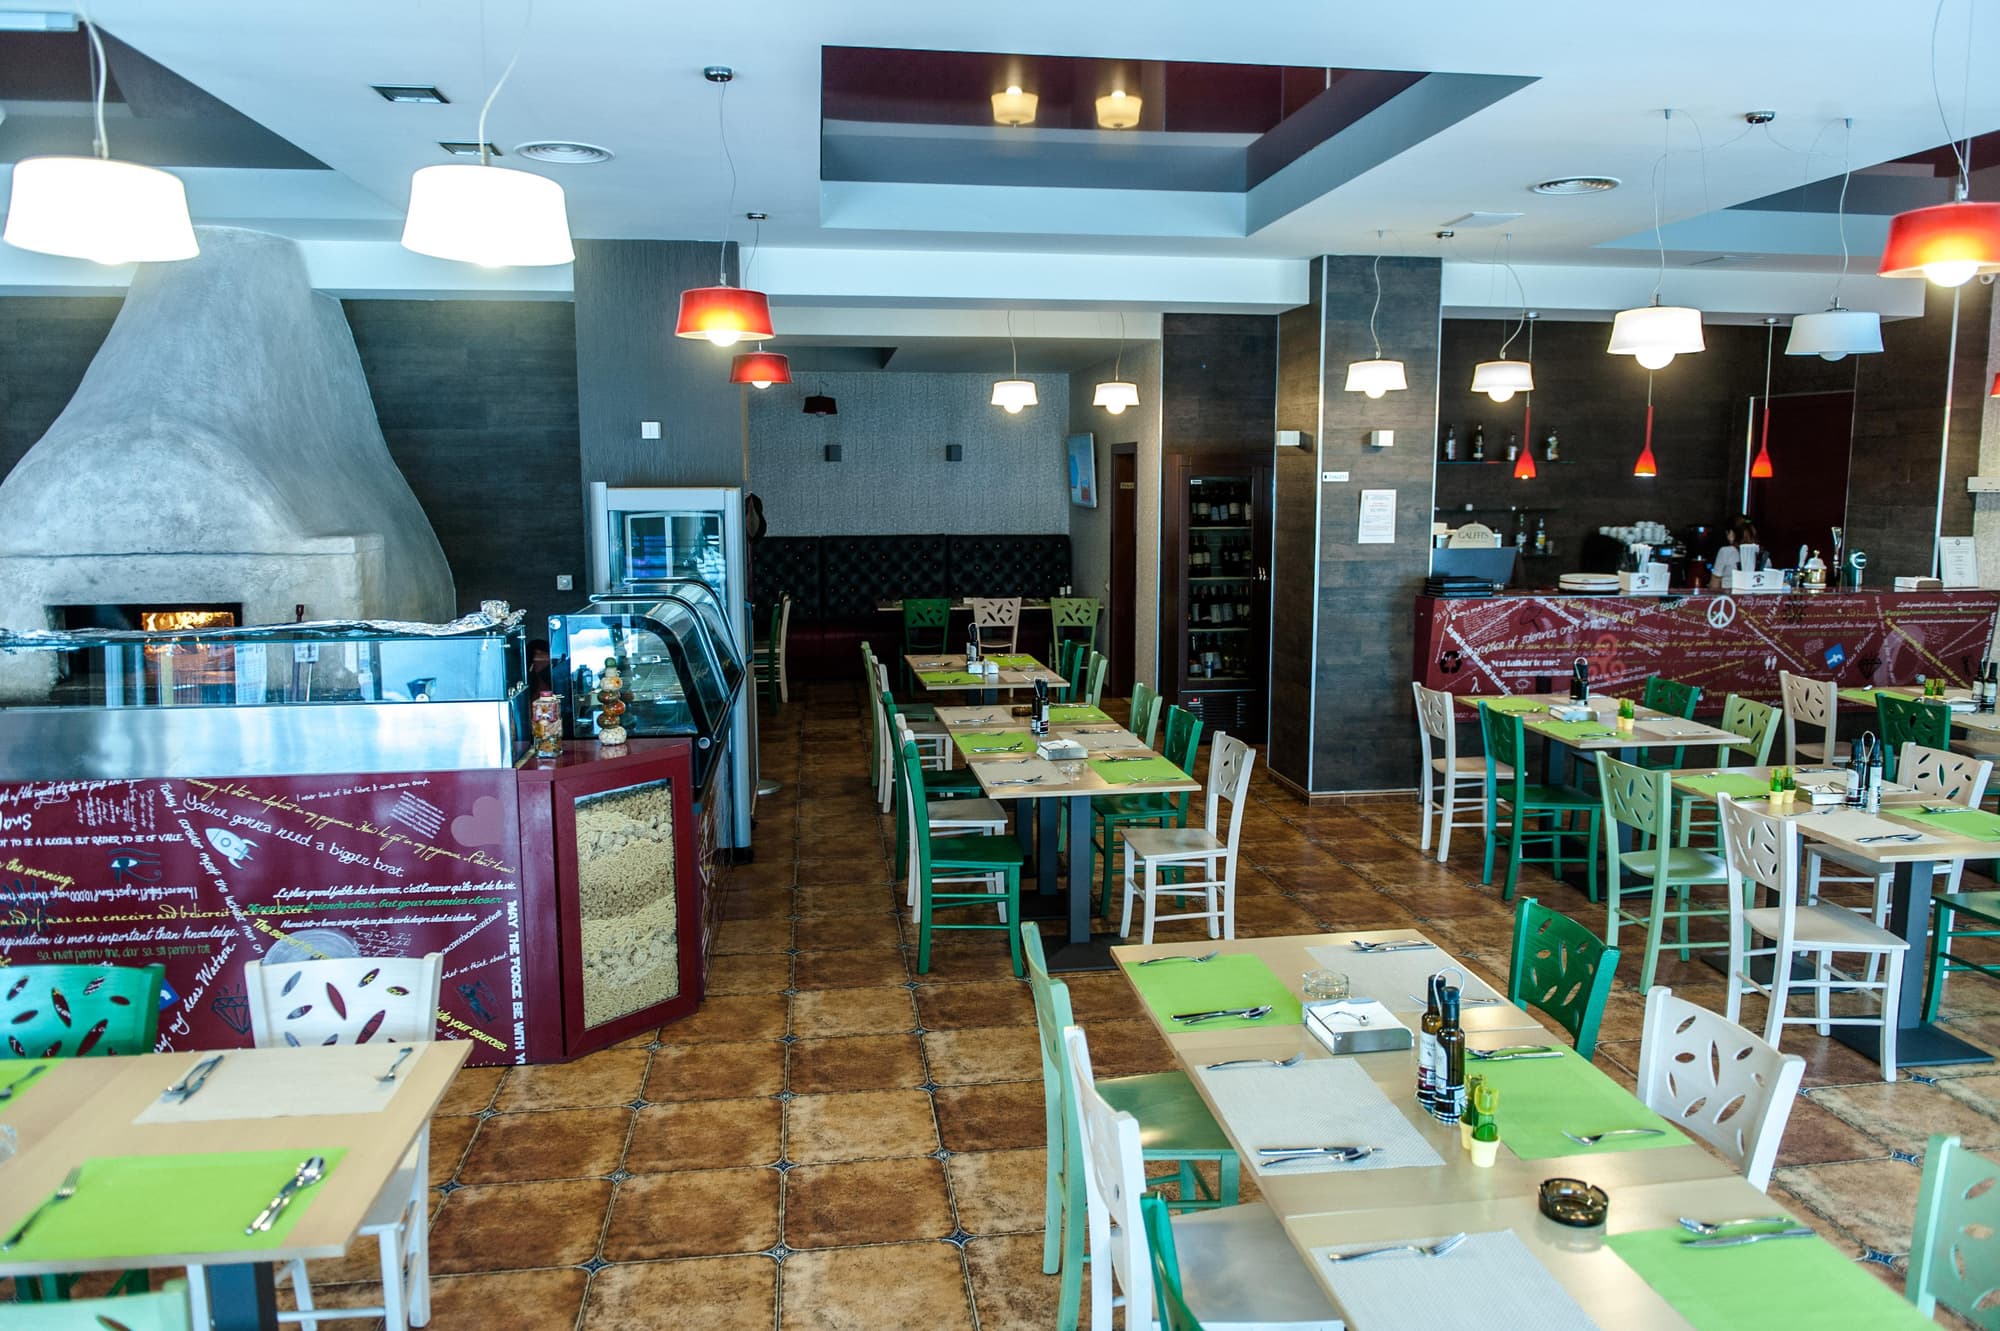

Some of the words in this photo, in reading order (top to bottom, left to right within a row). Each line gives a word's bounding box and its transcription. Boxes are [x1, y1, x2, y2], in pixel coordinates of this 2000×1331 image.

[183, 791, 229, 820] You're
[228, 813, 273, 836] gonna
[275, 826, 313, 848] need
[315, 840, 325, 851] a
[328, 841, 371, 866] bigger
[6, 858, 25, 876] the
[253, 918, 273, 934] The
[507, 900, 520, 929] MAY
[0, 931, 51, 954] agination
[53, 932, 66, 945] is
[66, 934, 95, 945] more
[97, 928, 156, 949] important
[156, 925, 181, 940] than
[183, 924, 240, 946] knowledge.
[508, 931, 521, 957] THE
[510, 956, 522, 999] FORCE
[169, 1010, 190, 1035] my
[183, 985, 204, 1013] dear
[436, 1006, 451, 1023] ide
[446, 1017, 473, 1032] your
[512, 1001, 524, 1019] BE
[514, 1021, 525, 1050] WITH
